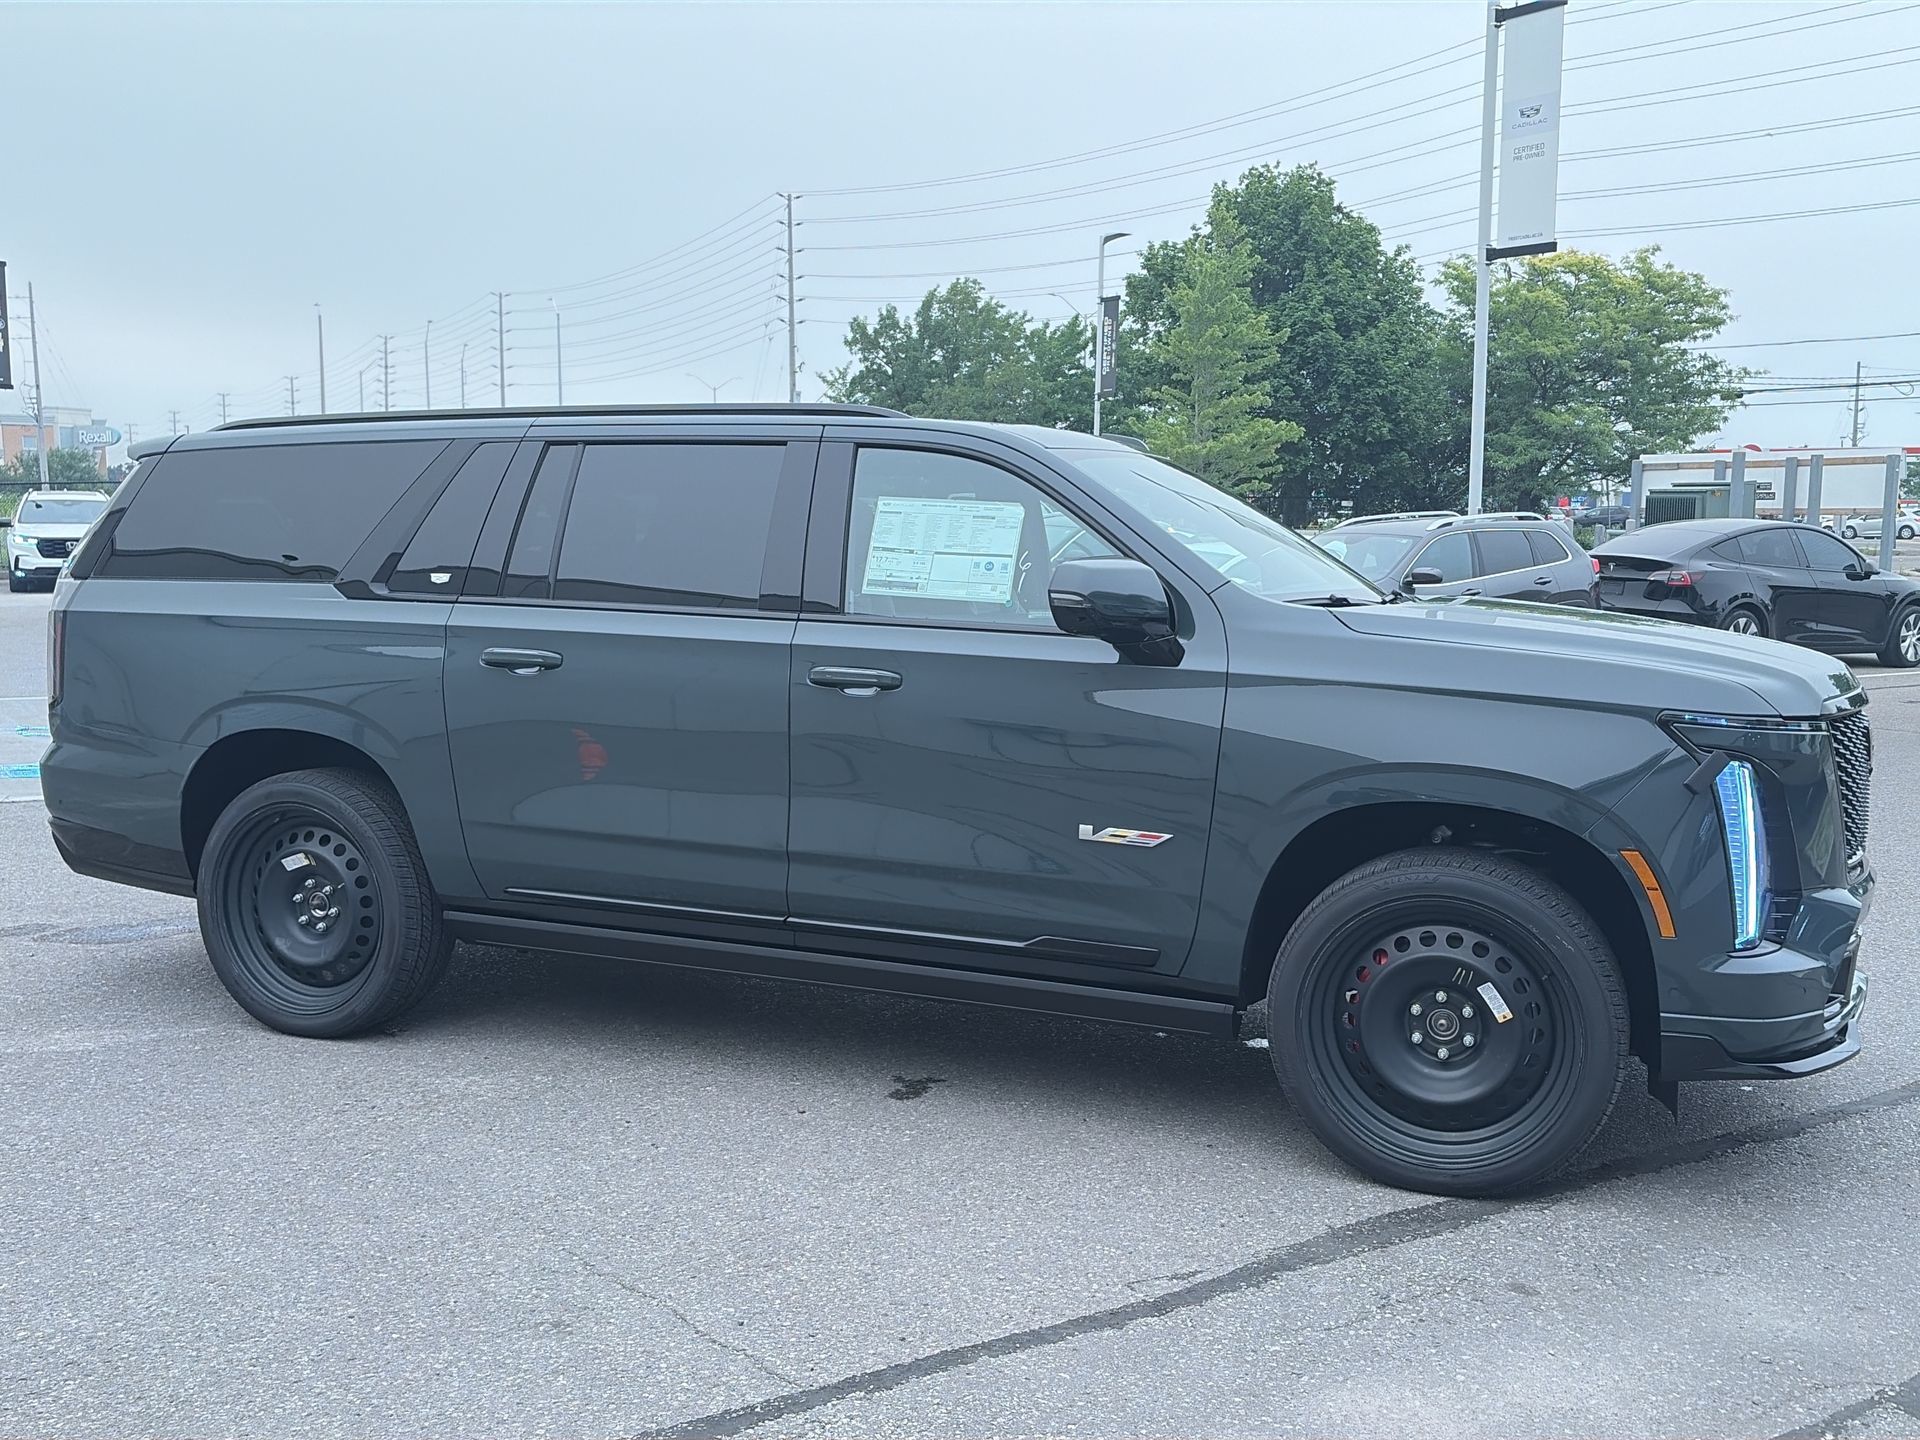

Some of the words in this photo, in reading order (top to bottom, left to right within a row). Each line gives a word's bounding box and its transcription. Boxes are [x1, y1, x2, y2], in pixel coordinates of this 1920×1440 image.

[1511, 117, 1548, 130] CADILLAC
[1513, 142, 1545, 155] CERTIFIED
[1512, 150, 1545, 162] PRE-OWNED
[79, 430, 112, 444] Rexall
